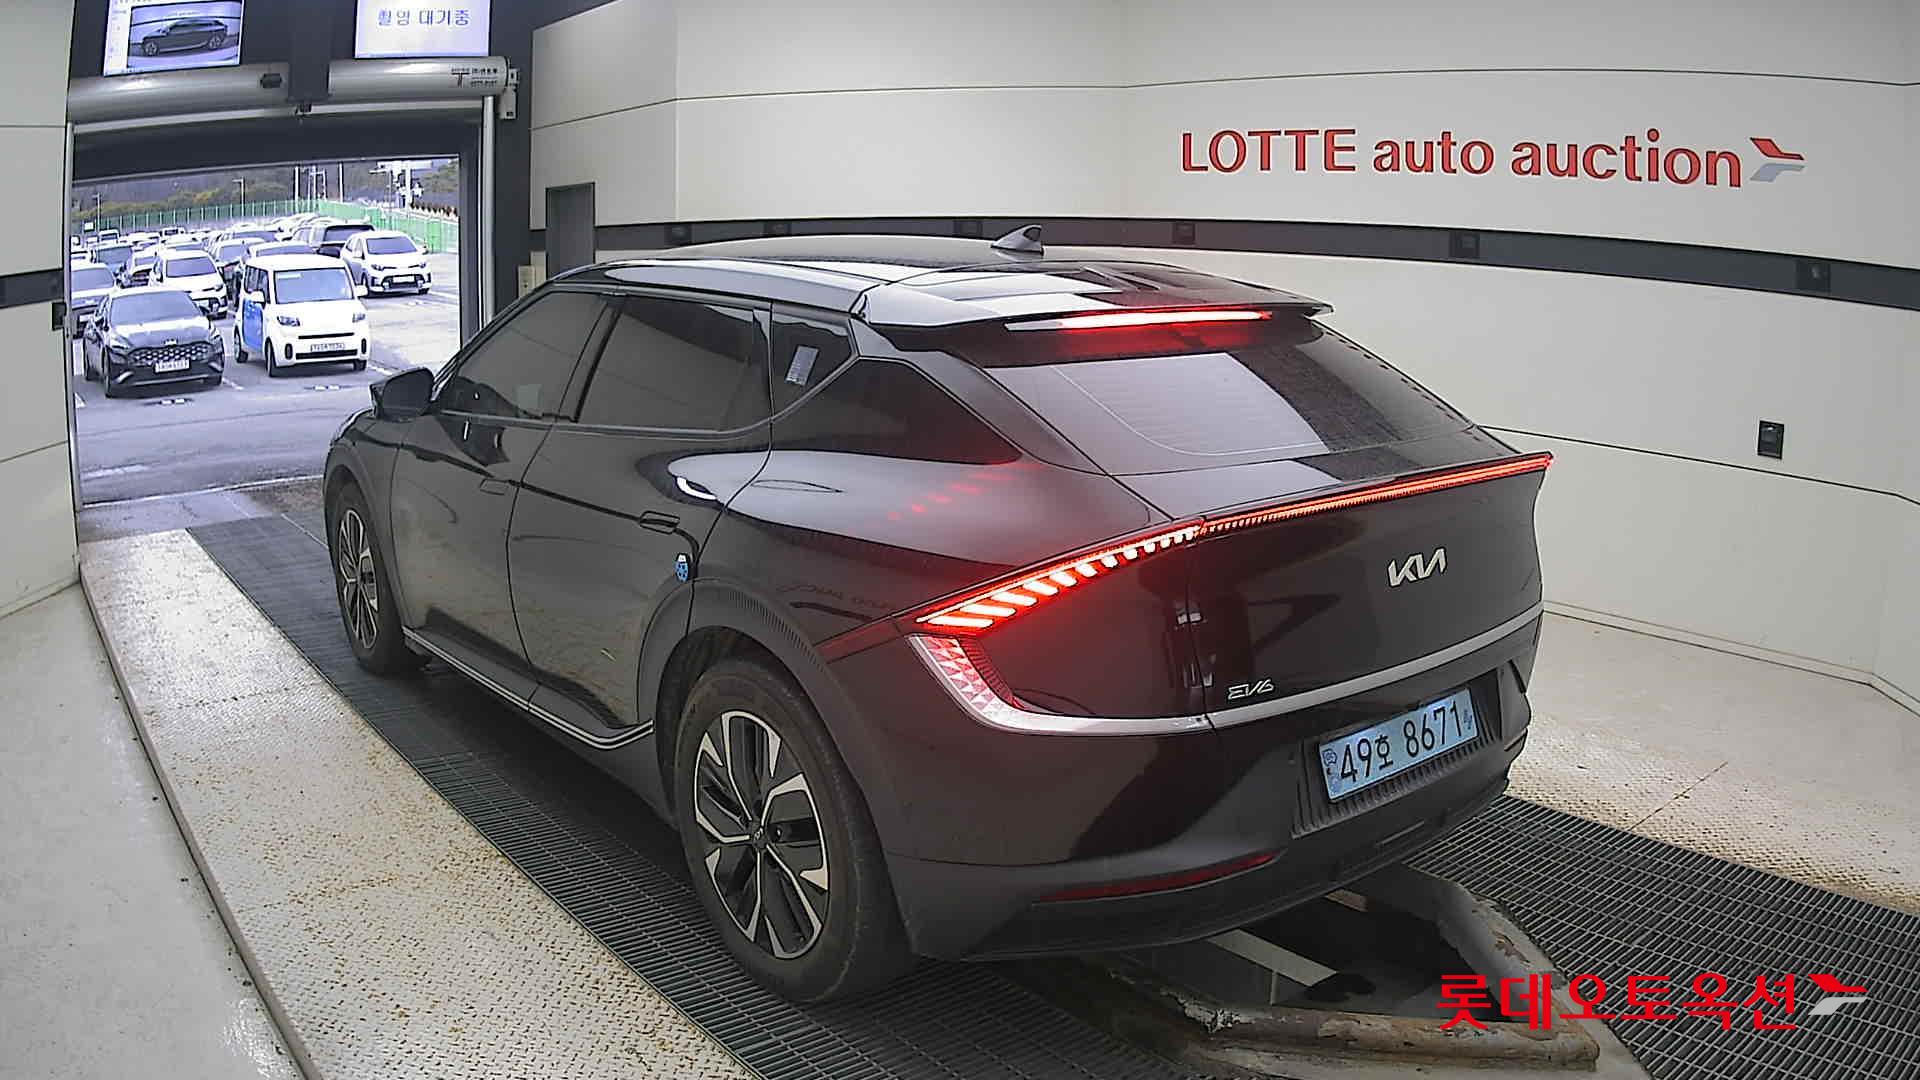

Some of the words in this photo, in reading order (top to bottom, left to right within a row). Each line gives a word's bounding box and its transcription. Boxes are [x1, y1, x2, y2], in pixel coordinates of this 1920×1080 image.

[418, 8, 470, 27] 대기중
[1181, 128, 1356, 173] LOTTE
[1373, 131, 1496, 175] auto
[1511, 128, 1743, 188] auction
[1227, 679, 1274, 700] EV6
[1340, 734, 1394, 783] 49호
[1403, 700, 1462, 758] 8671
